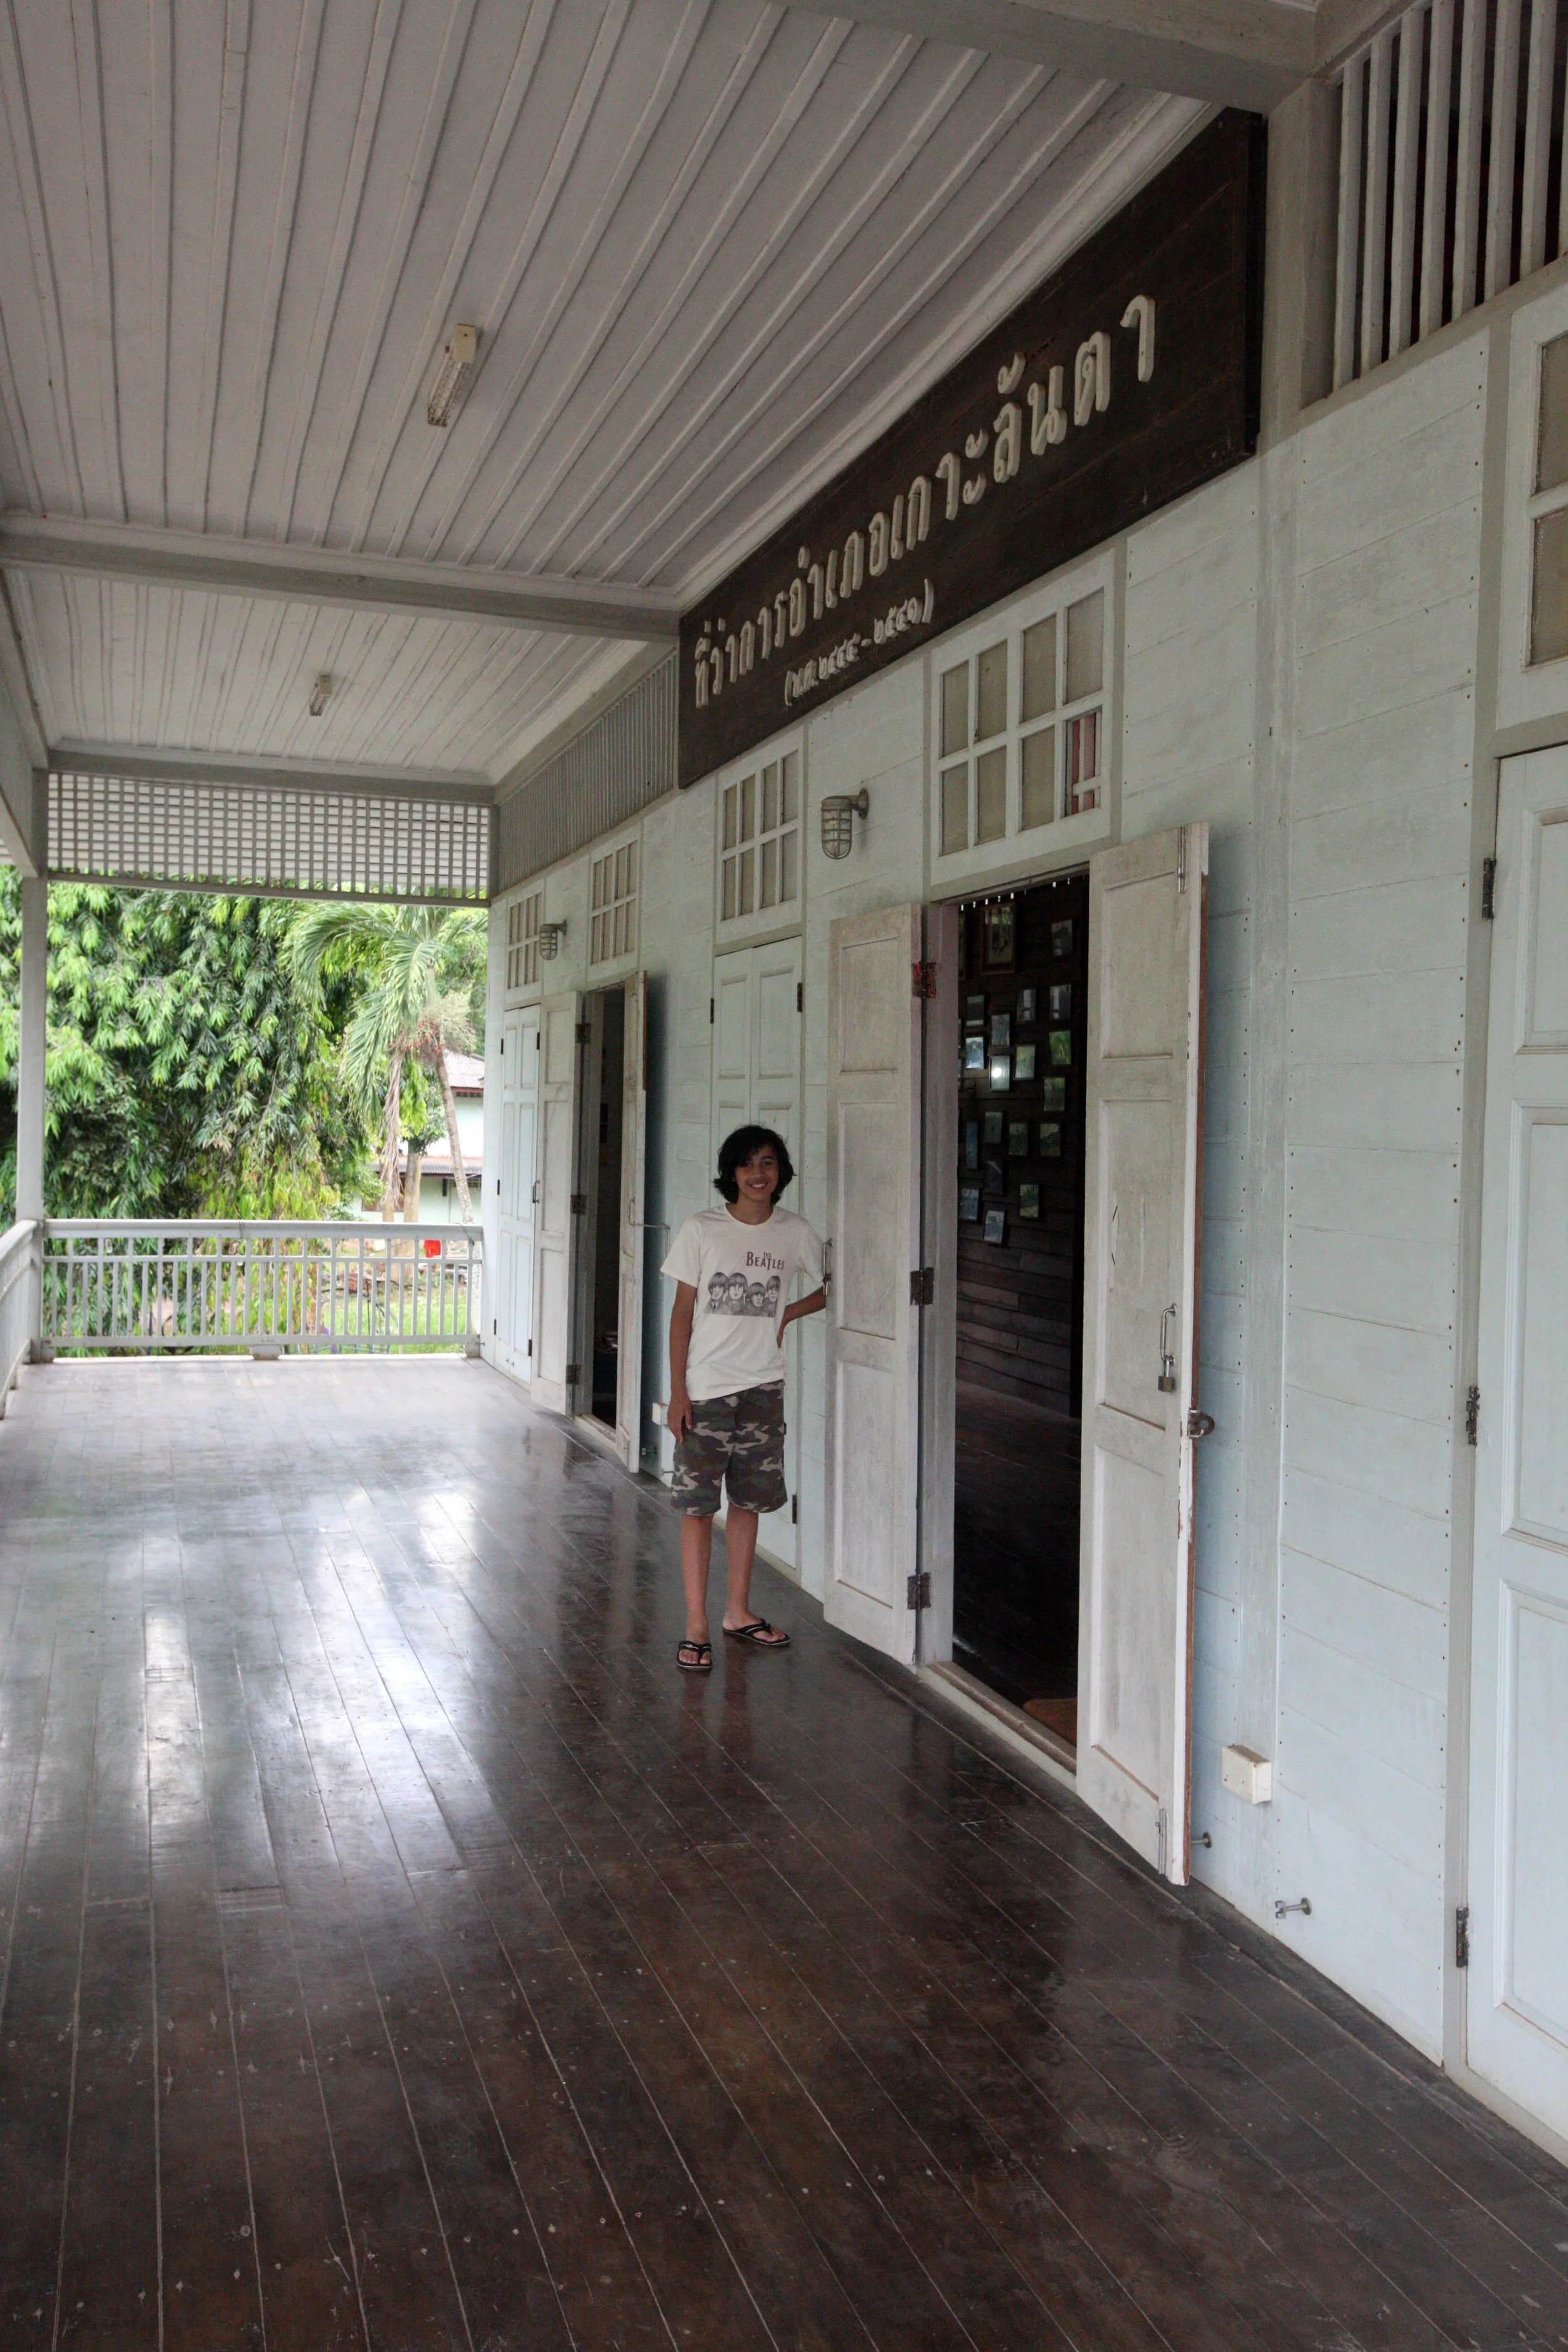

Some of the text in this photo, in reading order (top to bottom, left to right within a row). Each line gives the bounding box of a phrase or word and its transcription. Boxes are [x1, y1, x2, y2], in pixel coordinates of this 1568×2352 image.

[694, 294, 1155, 709] ที่ว่าการอำเภอเกาะลันตา
[746, 1251, 785, 1271] BEATLES
